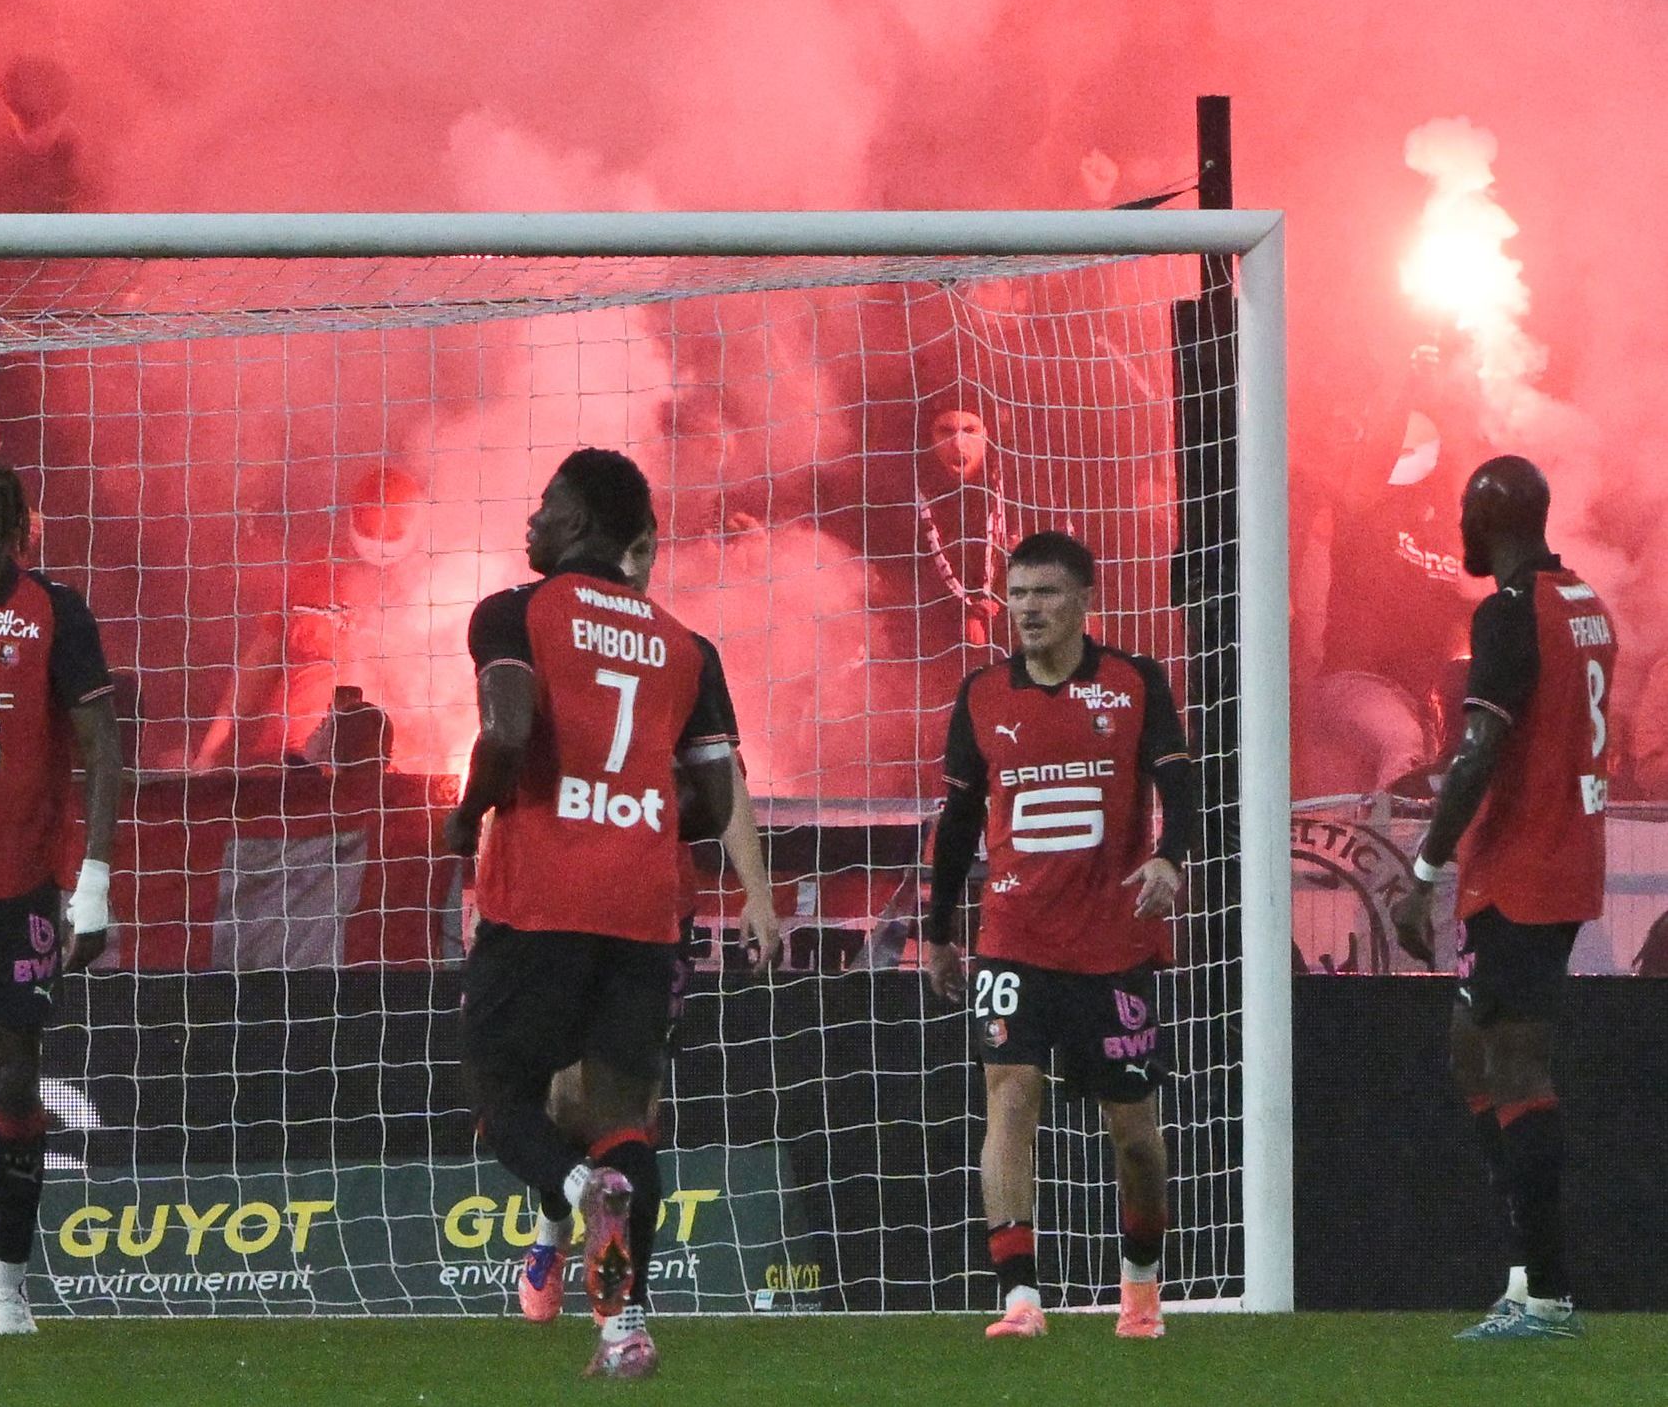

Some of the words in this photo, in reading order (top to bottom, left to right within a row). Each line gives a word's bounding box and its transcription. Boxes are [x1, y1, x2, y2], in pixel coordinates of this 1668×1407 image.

[574, 587, 654, 620] WINAMAX
[572, 618, 666, 668] EMBOLO
[595, 668, 640, 773] 7
[1000, 759, 1115, 787] SAMSIC
[557, 775, 664, 833] Blot
[975, 970, 1021, 1019] 26
[59, 1200, 335, 1257] GUYOT
[54, 1264, 315, 1294] environnement
